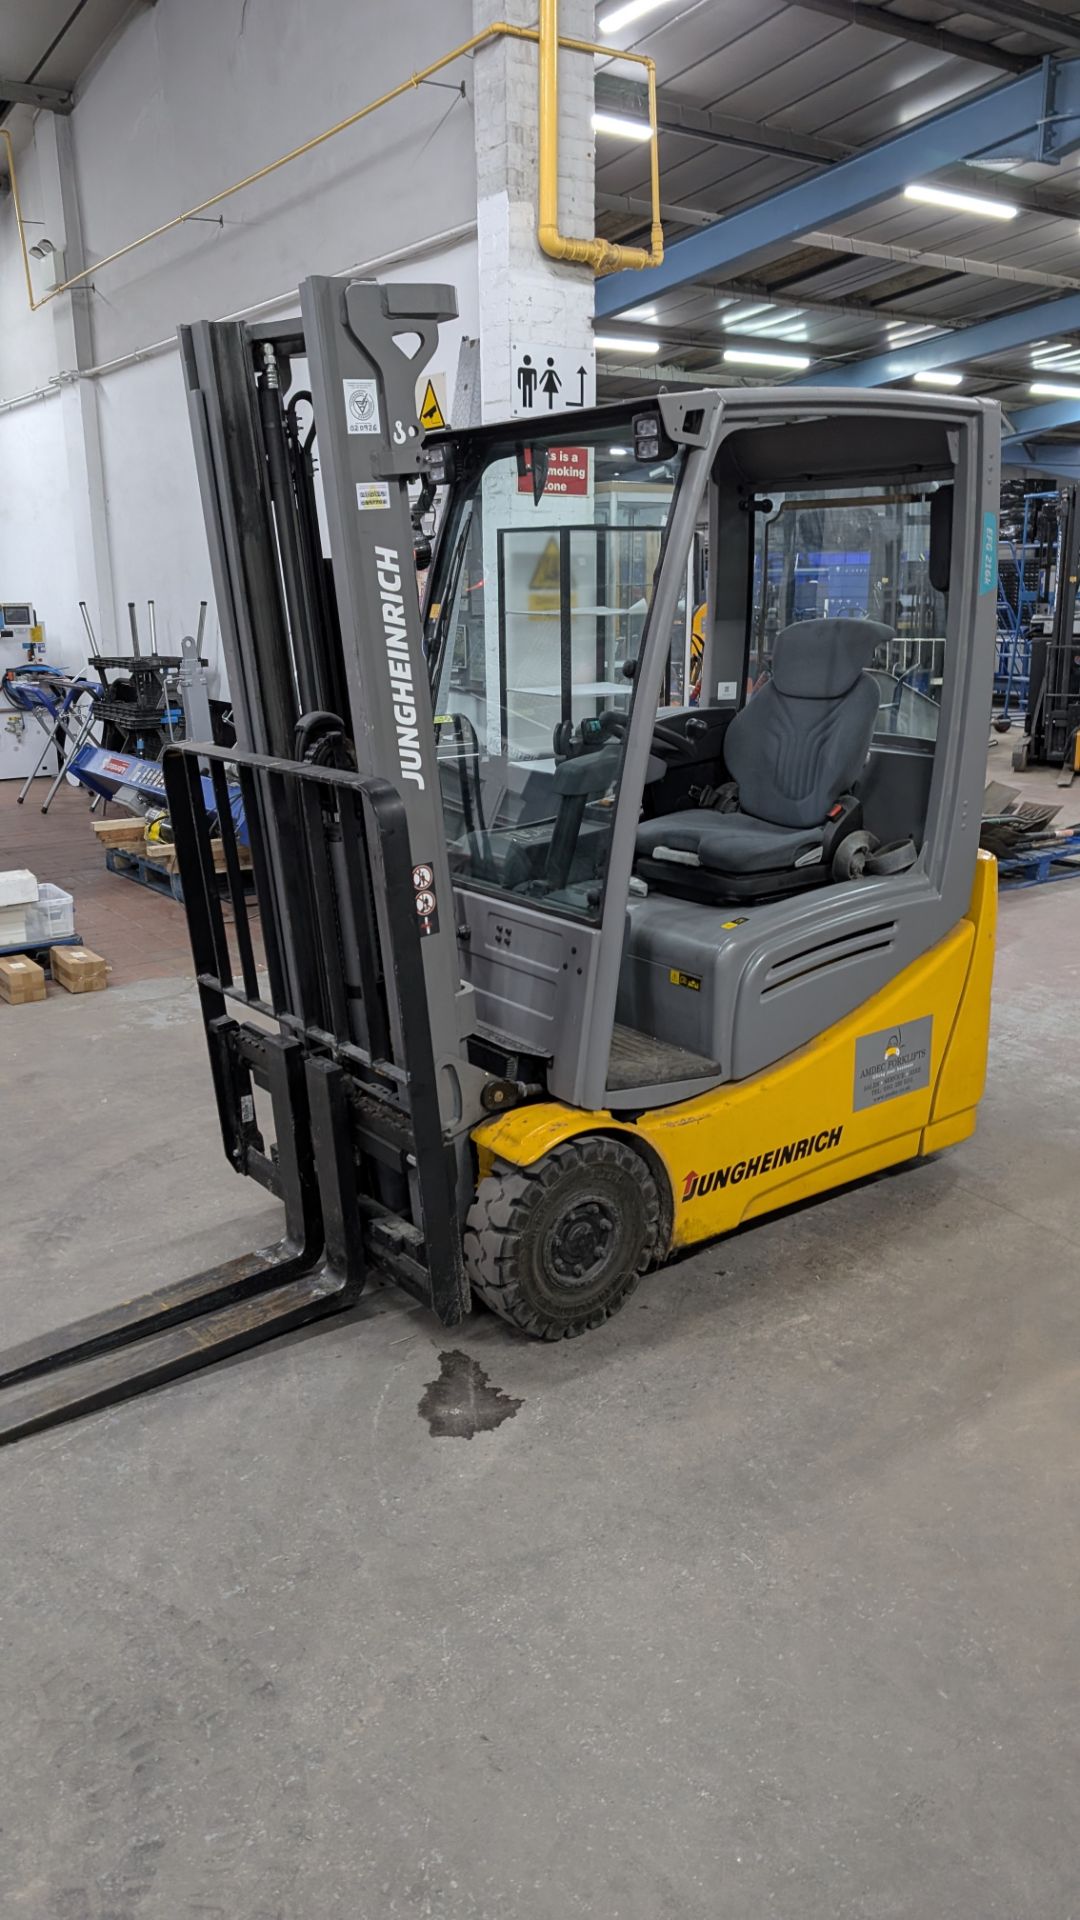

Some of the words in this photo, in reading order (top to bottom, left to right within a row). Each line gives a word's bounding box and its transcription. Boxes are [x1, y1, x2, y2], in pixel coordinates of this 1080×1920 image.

[559, 450, 569, 463] is
[571, 453, 579, 463] a
[374, 545, 425, 791] JUNGHEINRICH
[860, 1063, 886, 1079] AMDEC
[888, 1049, 926, 1068] FORKLIFTS
[682, 1125, 843, 1203] JUNGHEINRICH
